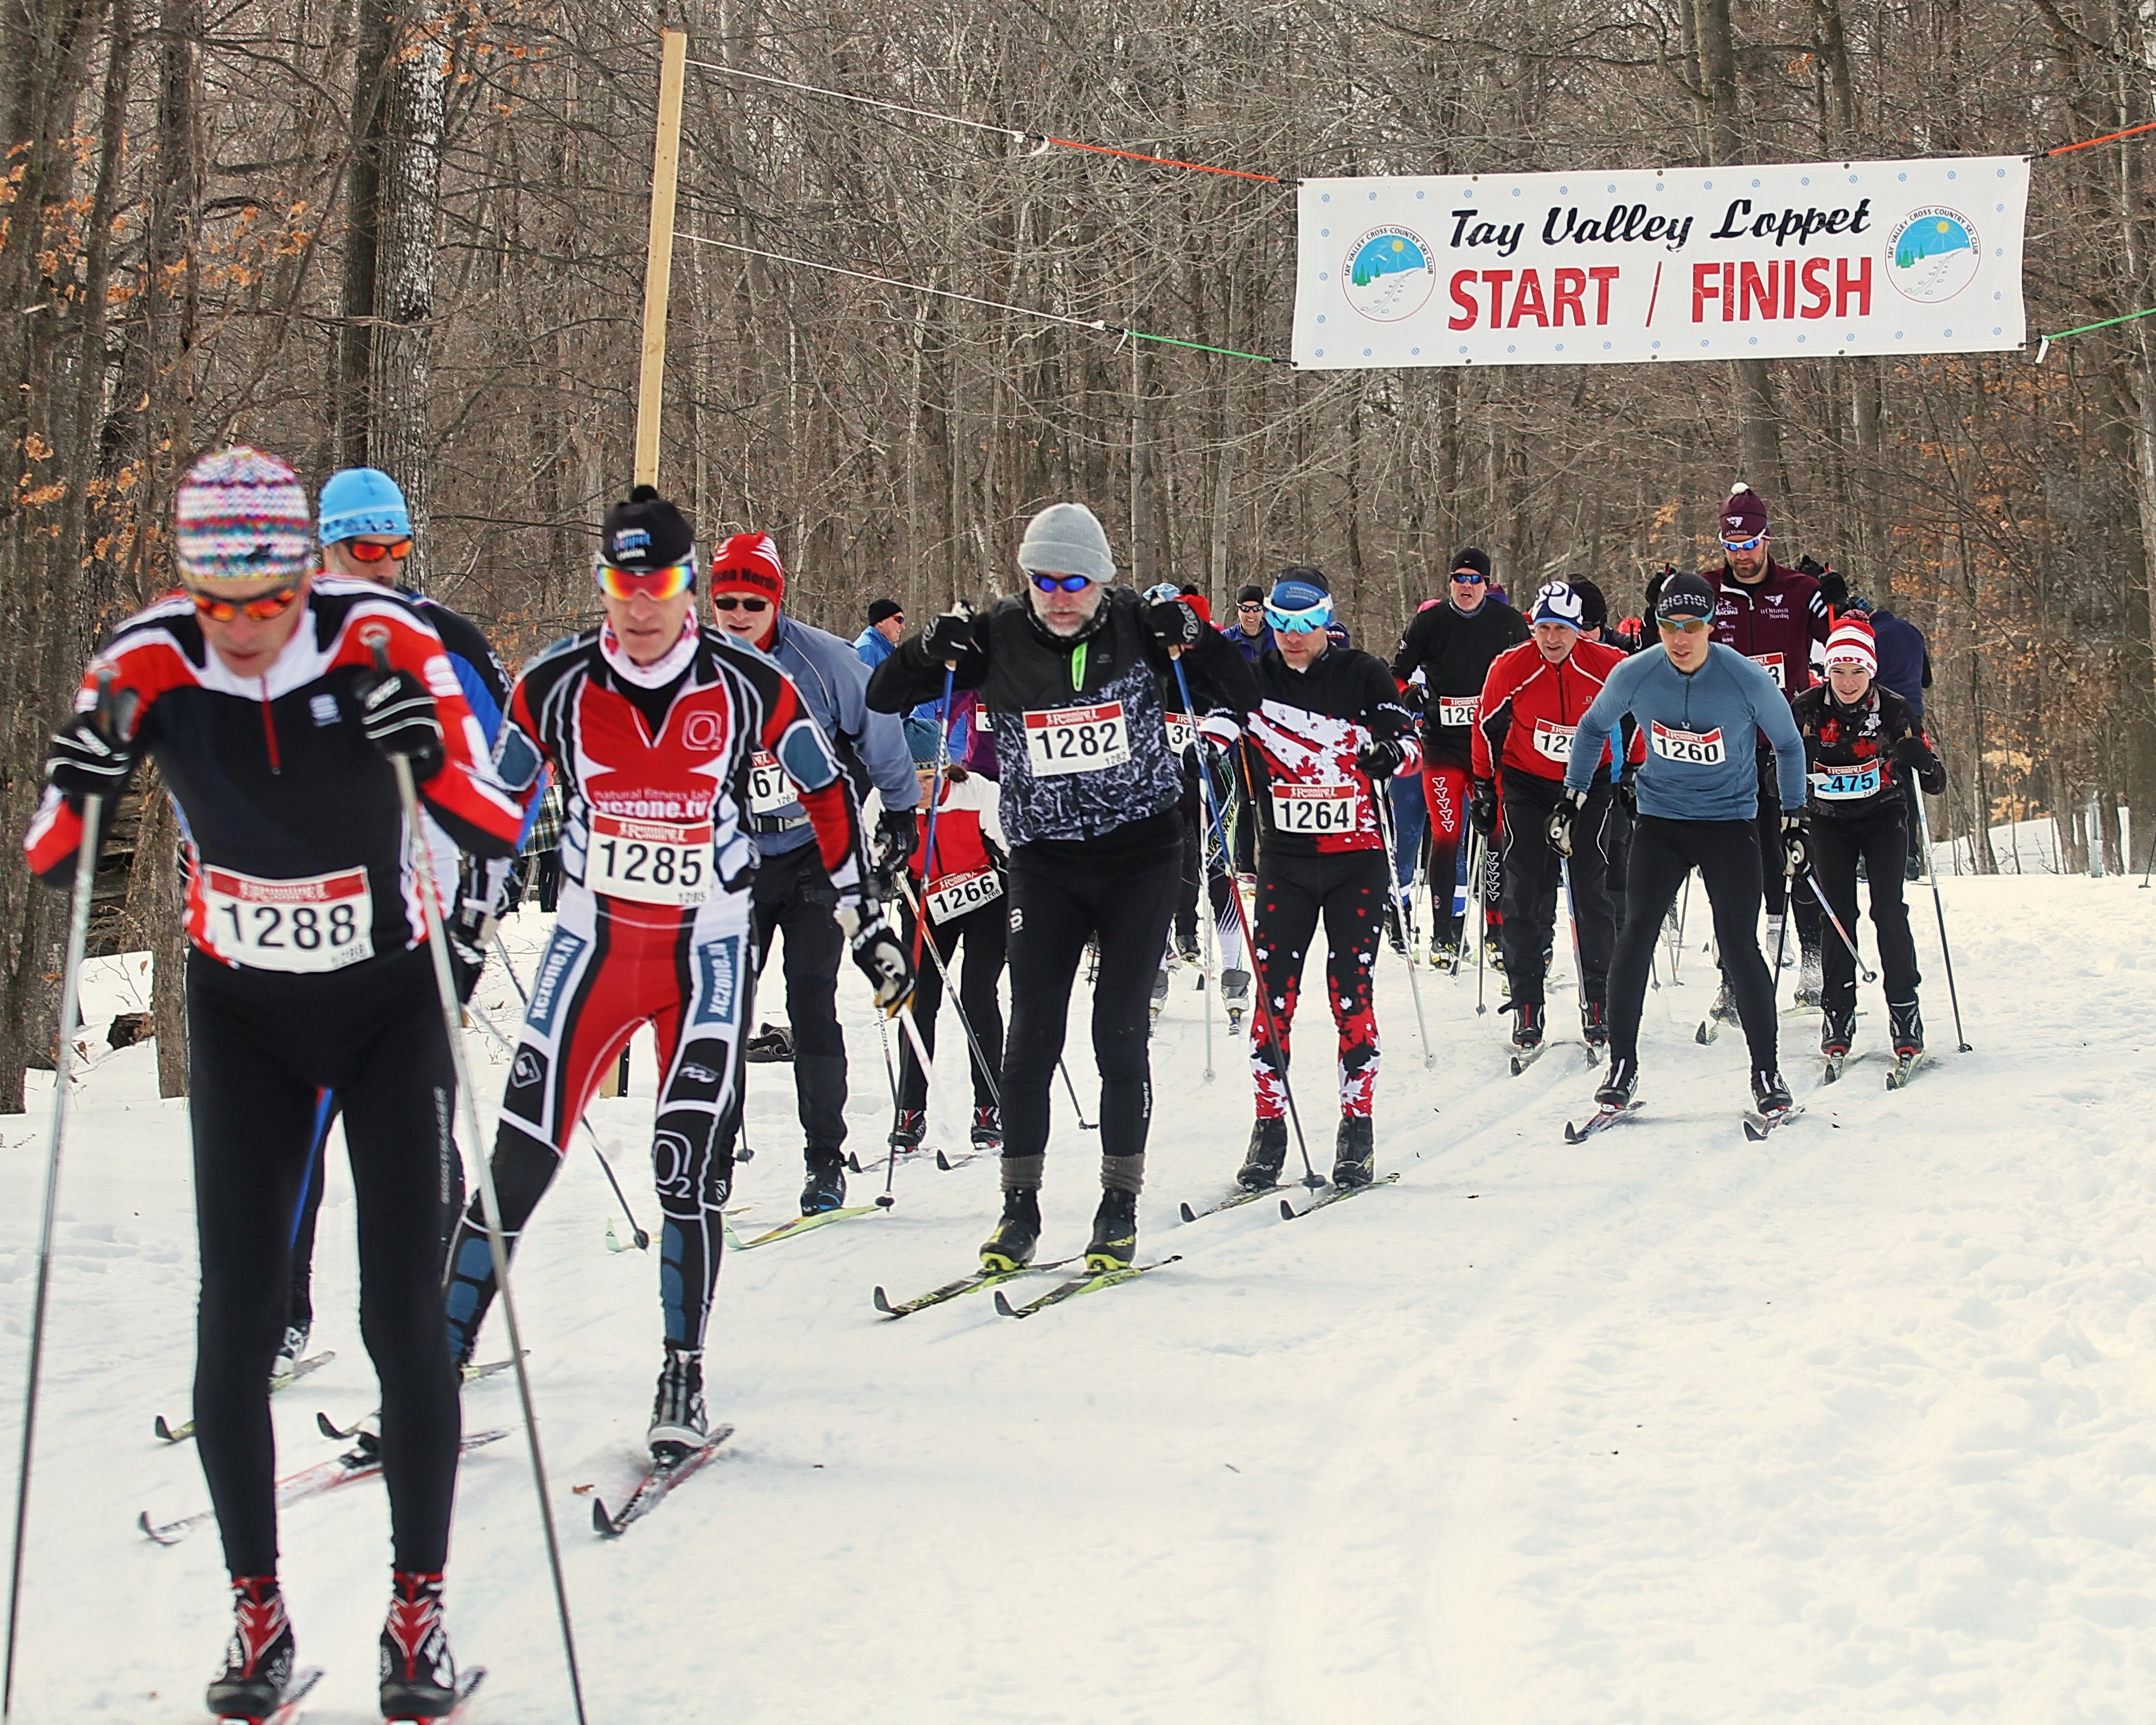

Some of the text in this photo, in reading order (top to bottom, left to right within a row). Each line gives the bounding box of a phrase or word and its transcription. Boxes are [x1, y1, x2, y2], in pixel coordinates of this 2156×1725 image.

[1450, 198, 1871, 257] Tay Valley Loppet
[1891, 220, 1908, 243] VALLEY
[1964, 224, 1974, 236] SKI
[1348, 238, 1365, 264] VALLEY
[1419, 244, 1429, 257] SKI
[1426, 257, 1434, 275] CLUB
[1448, 266, 1619, 330] START
[1692, 257, 1872, 323] FINISH
[1036, 722, 1120, 759] 1282
[1105, 751, 1127, 765] 1282
[1657, 738, 1718, 763] 1260
[750, 767, 786, 798] 67
[1280, 800, 1349, 830] 1264
[600, 840, 702, 887] 1285
[933, 875, 994, 914] 1266
[220, 903, 355, 950] 1288
